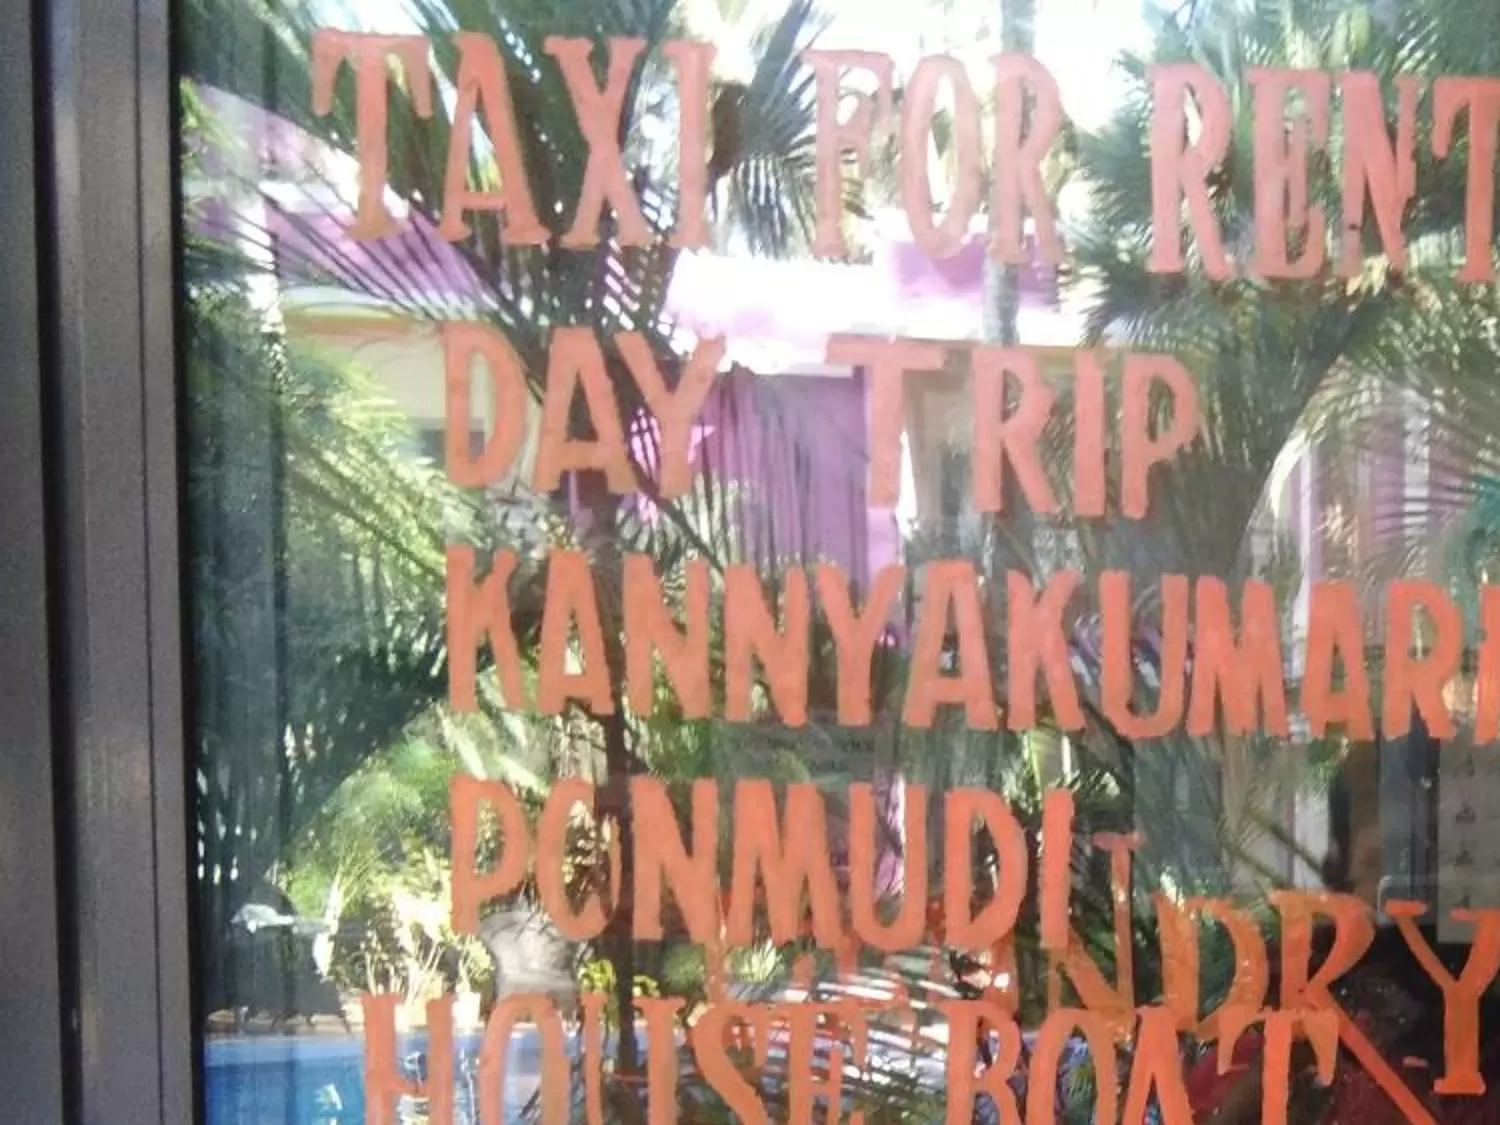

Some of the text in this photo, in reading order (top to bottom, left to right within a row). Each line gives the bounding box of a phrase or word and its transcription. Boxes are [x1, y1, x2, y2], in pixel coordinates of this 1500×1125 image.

[312, 27, 717, 250] TAXI
[805, 48, 1064, 266] FOR
[440, 320, 1203, 520] DAY TRIP
[448, 773, 1075, 953] PONMUDI
